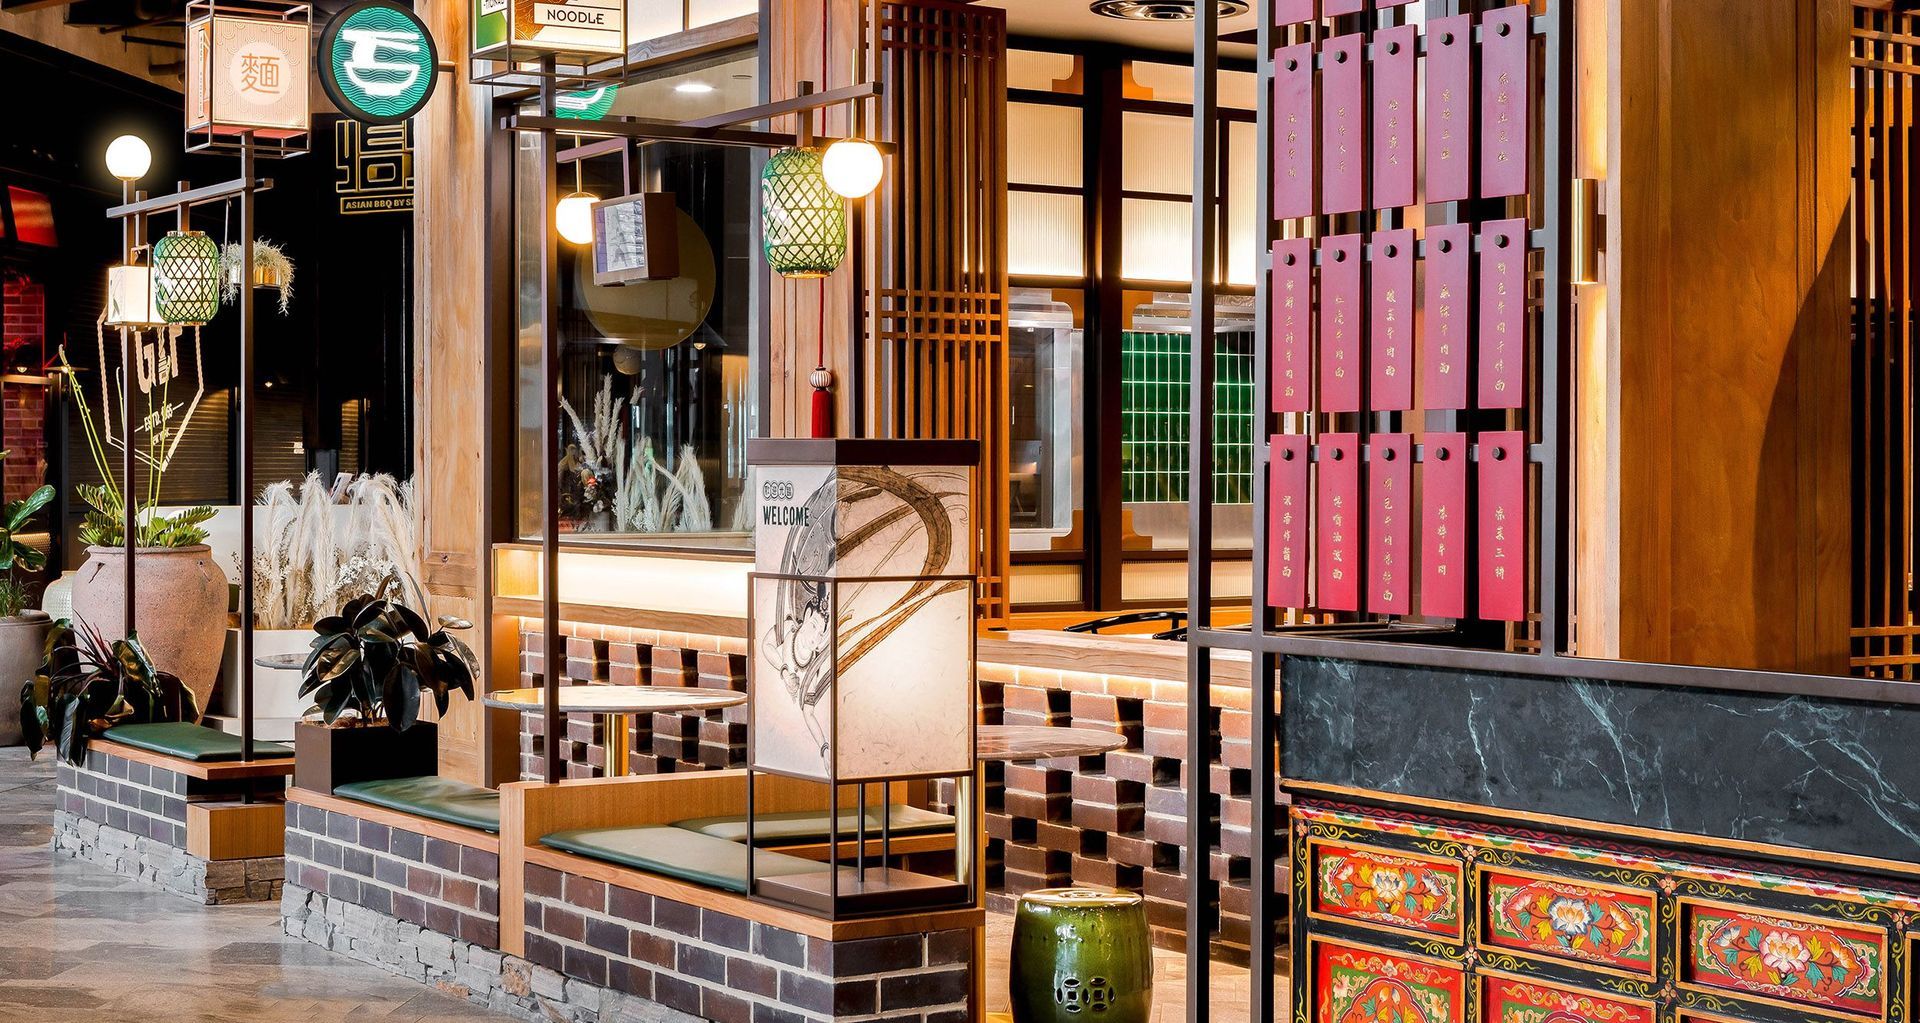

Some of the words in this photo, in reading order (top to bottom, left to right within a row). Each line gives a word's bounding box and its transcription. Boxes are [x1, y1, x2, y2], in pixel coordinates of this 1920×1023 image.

[547, 8, 604, 24] NOODLE
[240, 52, 281, 95] 麵
[345, 200, 373, 210] ASIAN
[374, 199, 393, 209] BBQ
[393, 198, 405, 206] BY
[763, 506, 810, 527] WELCOME
